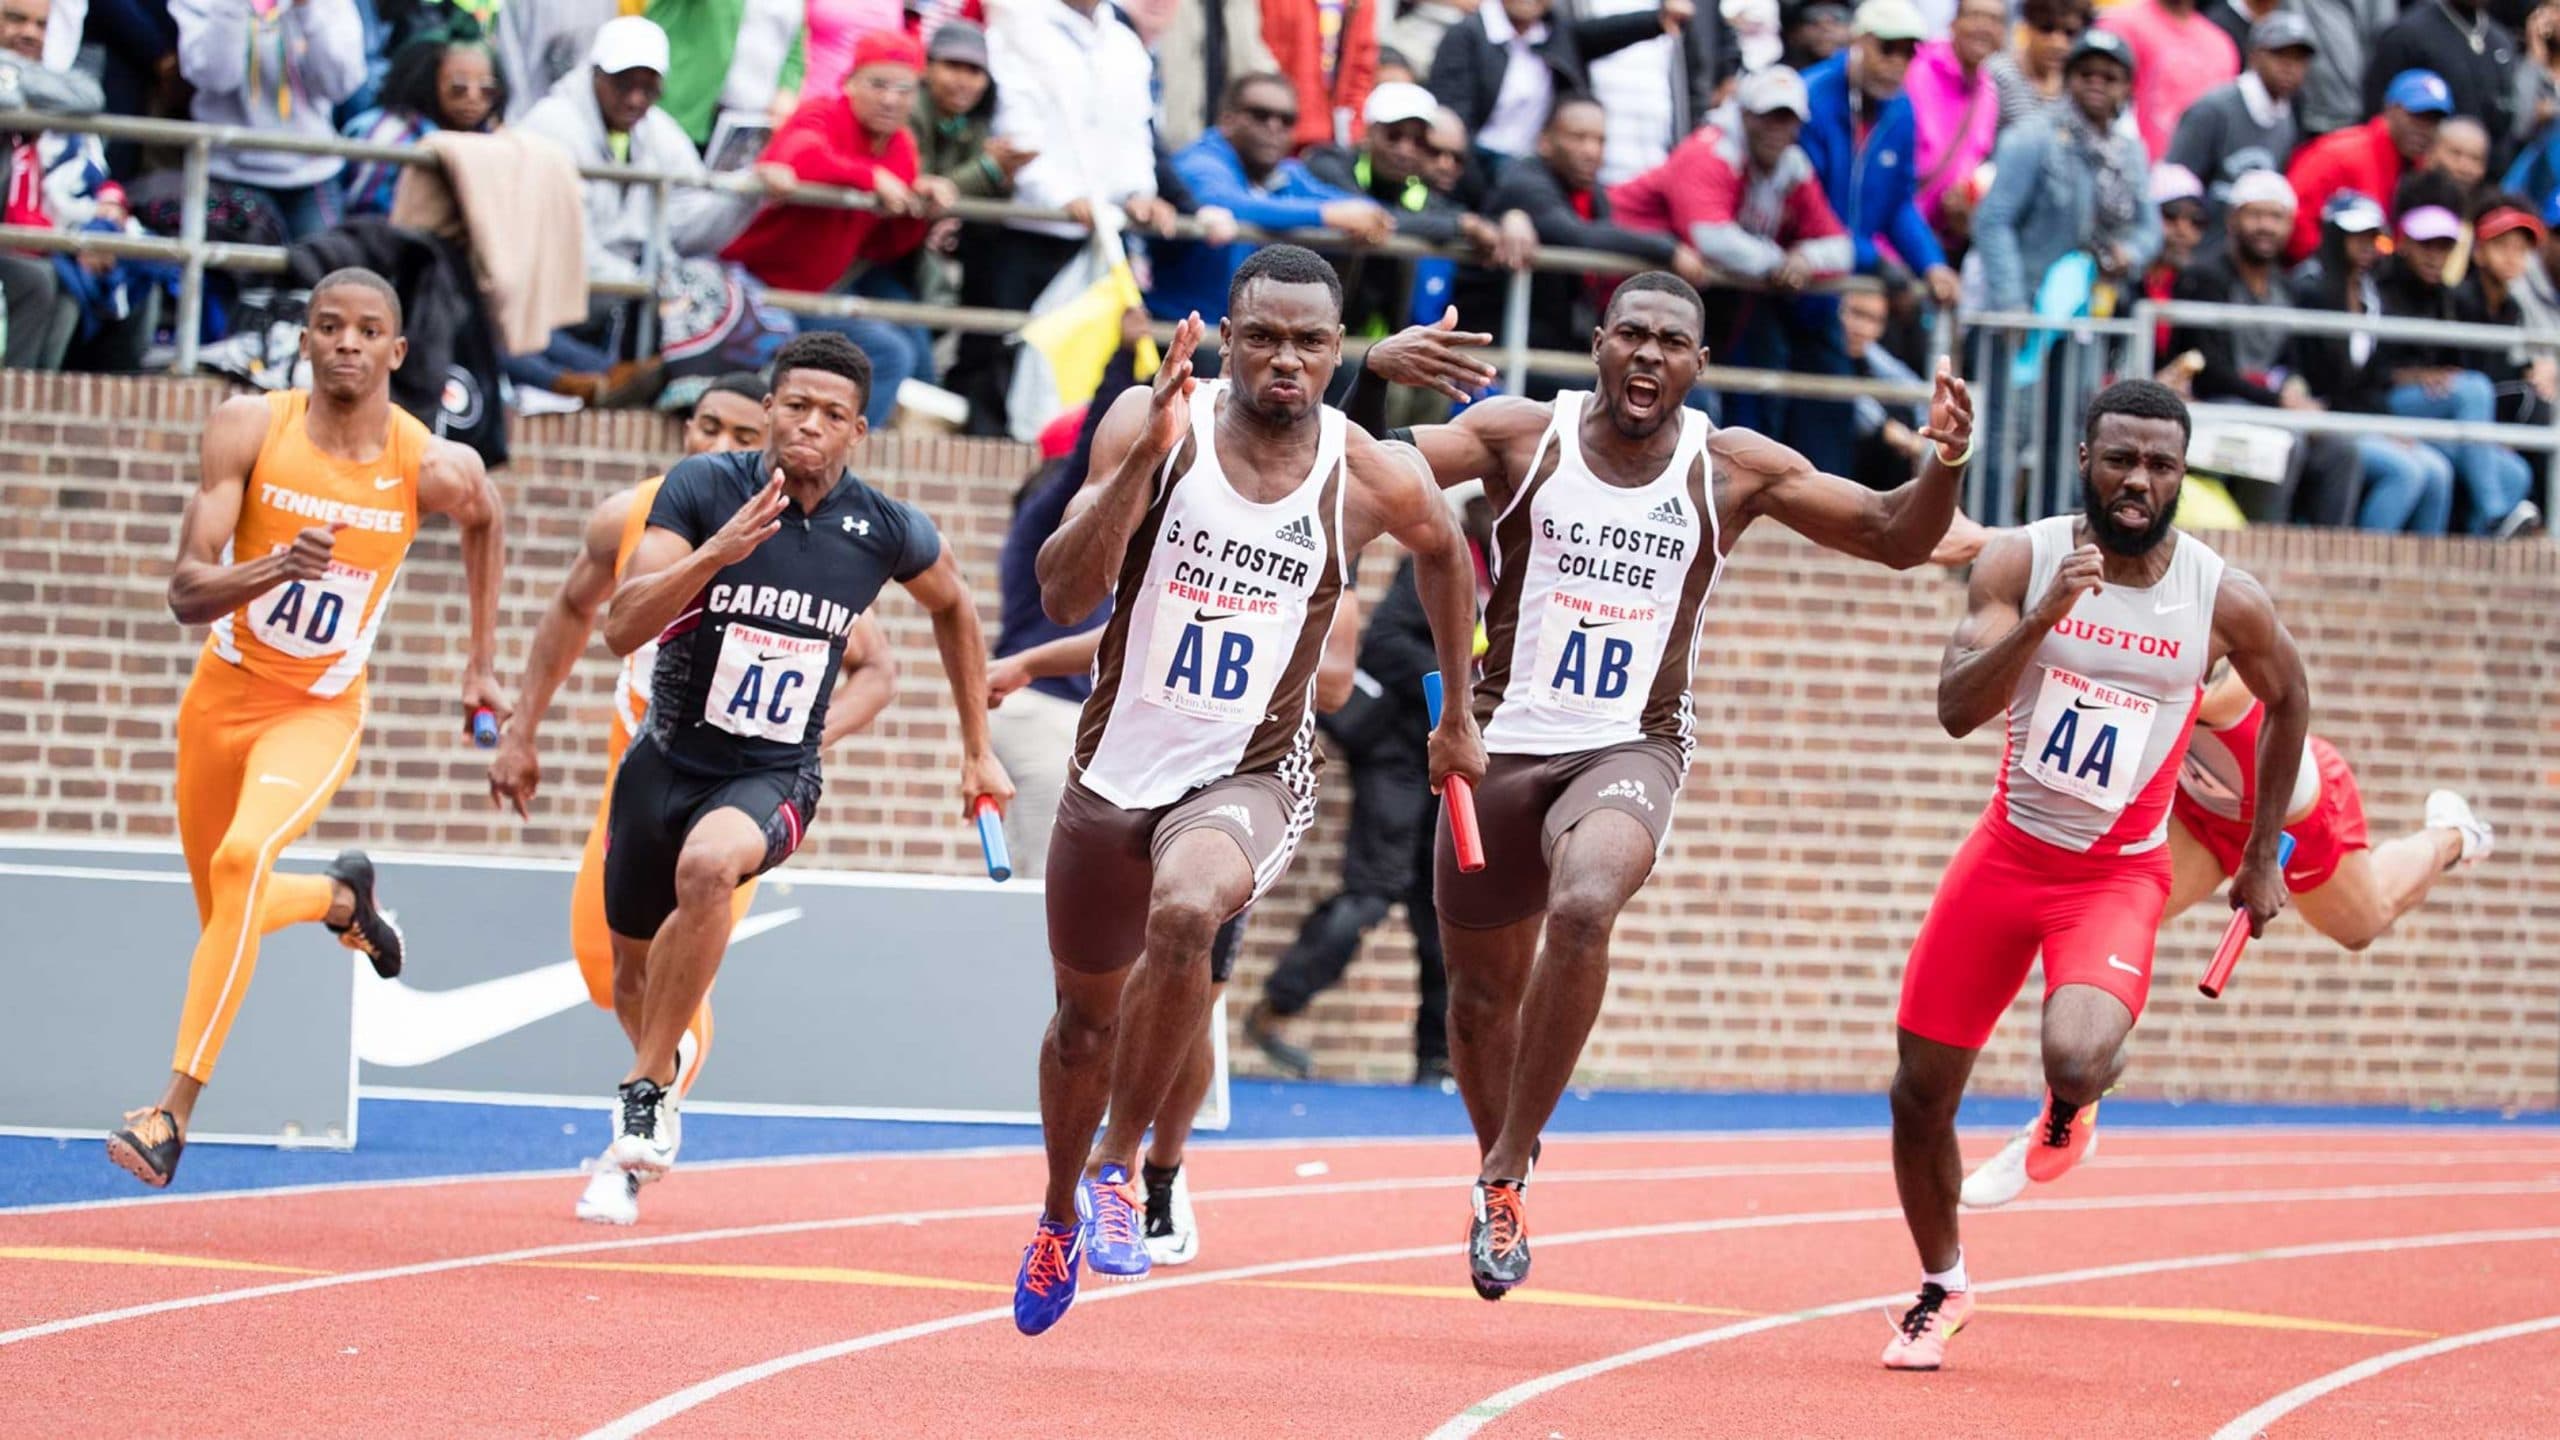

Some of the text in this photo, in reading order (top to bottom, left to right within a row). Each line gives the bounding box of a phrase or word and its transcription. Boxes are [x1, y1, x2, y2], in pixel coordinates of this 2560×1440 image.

[261, 483, 404, 533] TENNESSEE
[1648, 511, 1688, 528] adidas
[1167, 520, 1309, 587] G. C. FOSTER
[1275, 530, 1317, 551] adidas
[1542, 519, 1685, 561] G. C. FOSTER
[1558, 553, 1657, 590] COLLEGE
[266, 582, 345, 645] AD
[1169, 581, 1278, 615] PENN RELAYS
[1554, 592, 1655, 622] PENN RELAYS
[732, 627, 772, 647] PENN
[2054, 617, 2181, 660] OUSTON
[1165, 622, 1254, 700] AB
[1551, 630, 1633, 699] AB
[726, 664, 804, 724] AC
[2052, 669, 2149, 714] PENN RELAYS
[2040, 708, 2118, 788] AA
